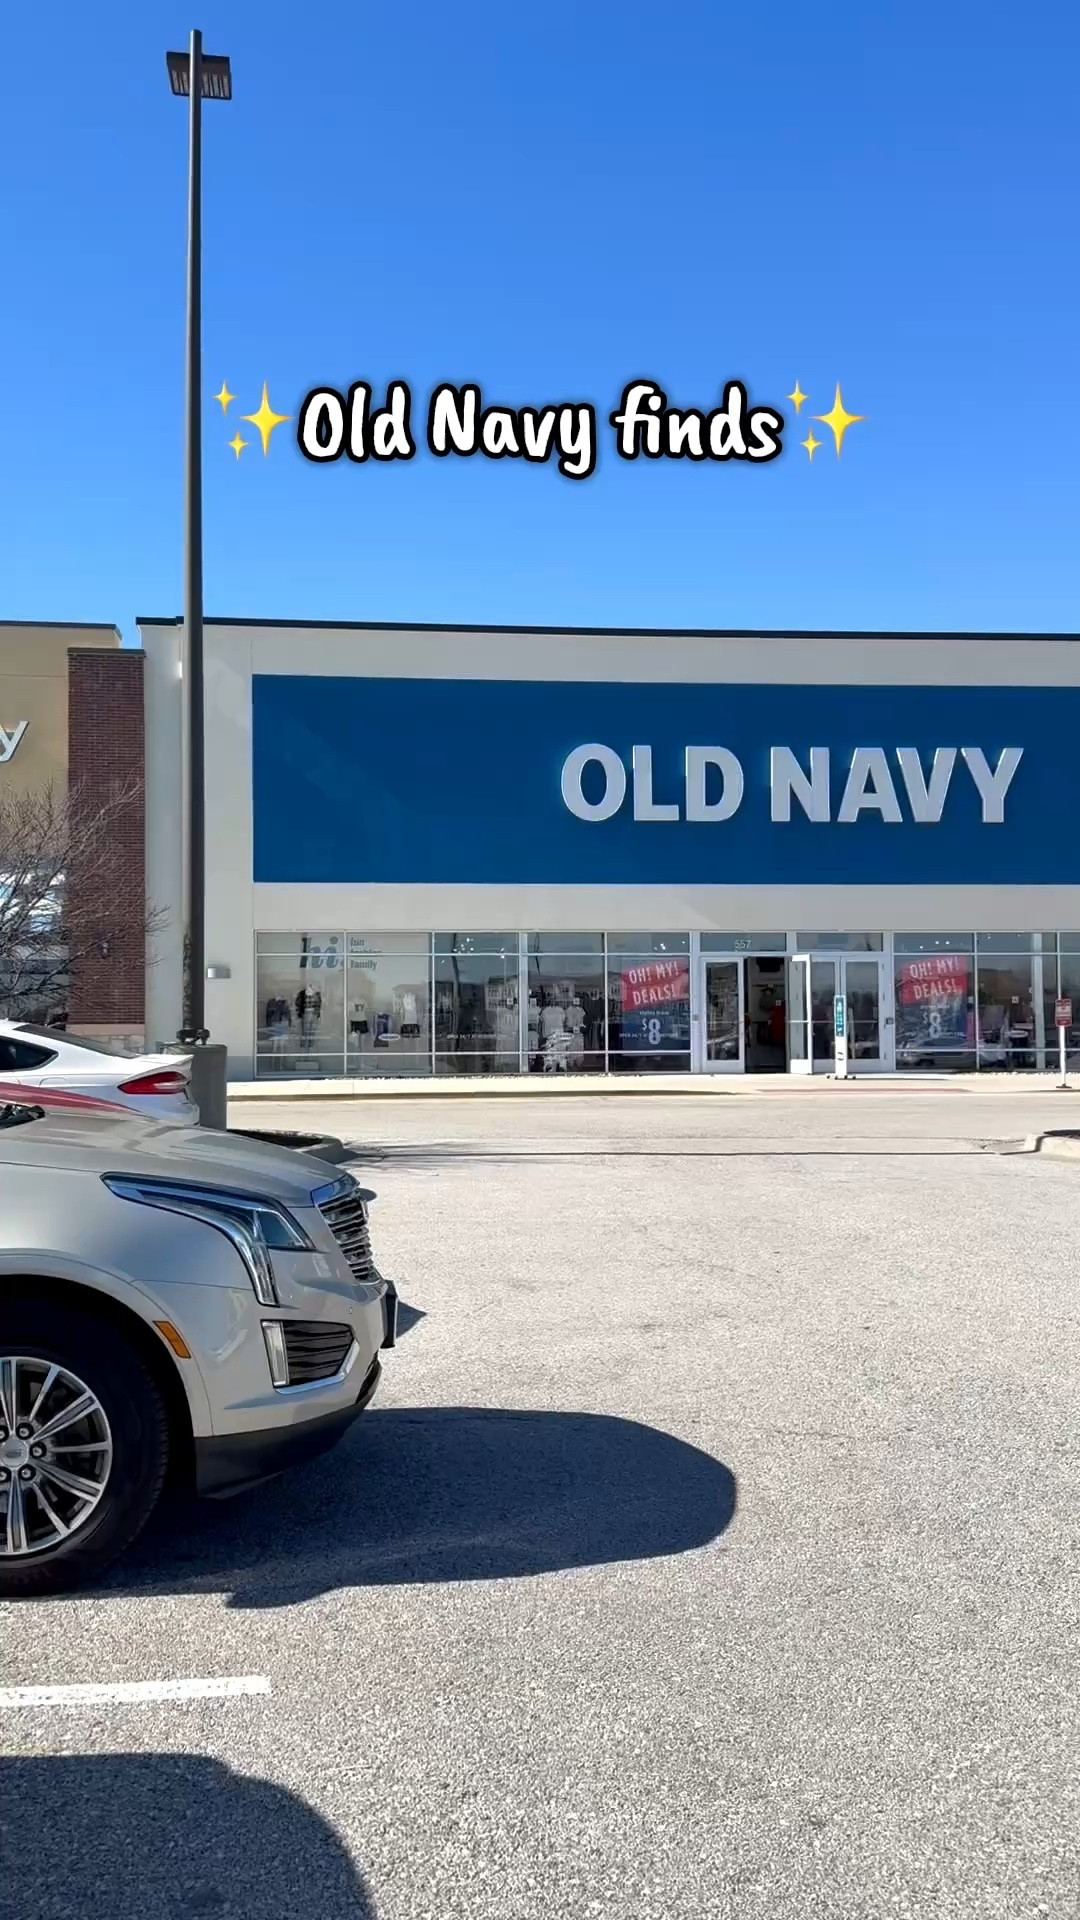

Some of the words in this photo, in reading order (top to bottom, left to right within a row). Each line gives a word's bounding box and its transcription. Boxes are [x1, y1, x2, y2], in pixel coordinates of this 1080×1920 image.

[561, 743, 744, 822] OLD
[770, 746, 1024, 823] NAVY
[629, 967, 651, 984] OH!
[656, 961, 679, 979] MY!
[910, 962, 932, 978] OH!
[937, 956, 959, 973] MY!
[632, 984, 675, 1005] DEALS!
[913, 978, 956, 1000] DEALS!
